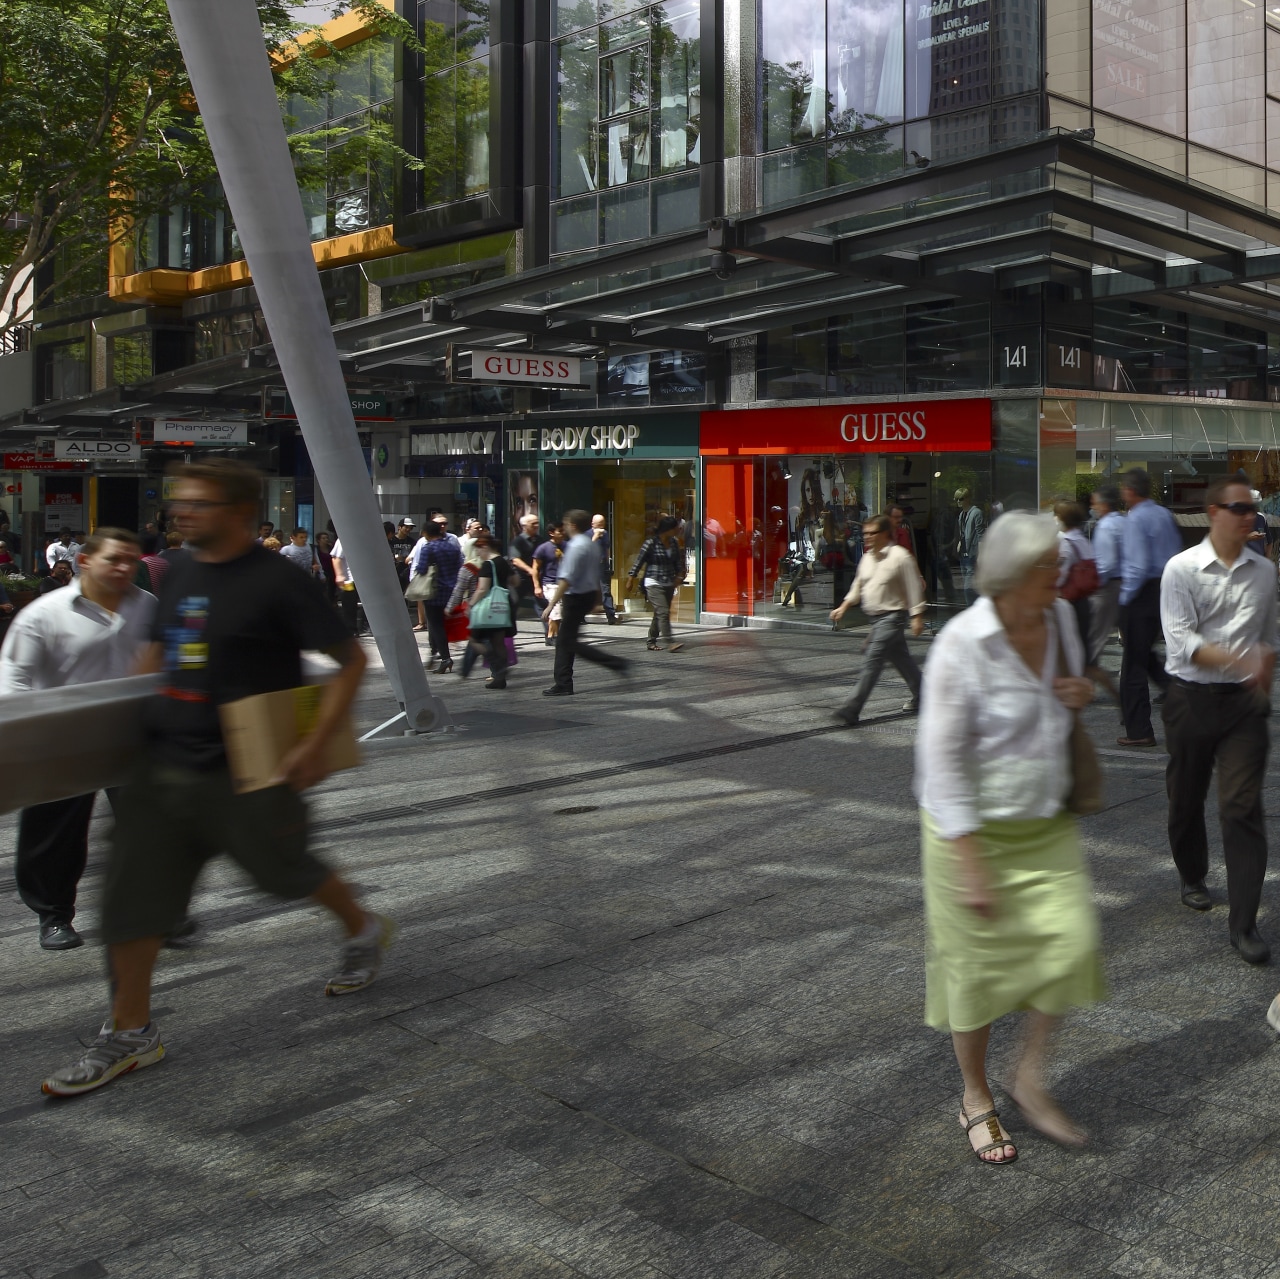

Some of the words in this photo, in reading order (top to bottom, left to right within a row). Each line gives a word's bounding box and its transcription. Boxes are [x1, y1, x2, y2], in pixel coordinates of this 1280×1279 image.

[943, 17, 962, 31] LEVEL
[963, 15, 969, 25] 2
[958, 21, 990, 39] SPECIALIS
[1124, 9, 1160, 35] Centre
[1106, 62, 1146, 94] SALE
[484, 356, 570, 378] GUESS
[1003, 345, 1027, 368] 141
[1059, 345, 1081, 369] 141
[351, 400, 381, 410] SHOP
[165, 422, 237, 433] Pharmacy
[840, 410, 927, 442] GUESS
[66, 442, 131, 453] ALDO
[411, 430, 497, 456] PHARMACY
[505, 428, 538, 452] THE
[540, 426, 589, 451] BODY
[590, 424, 640, 450] SHOP
[10, 455, 35, 463] VAP
